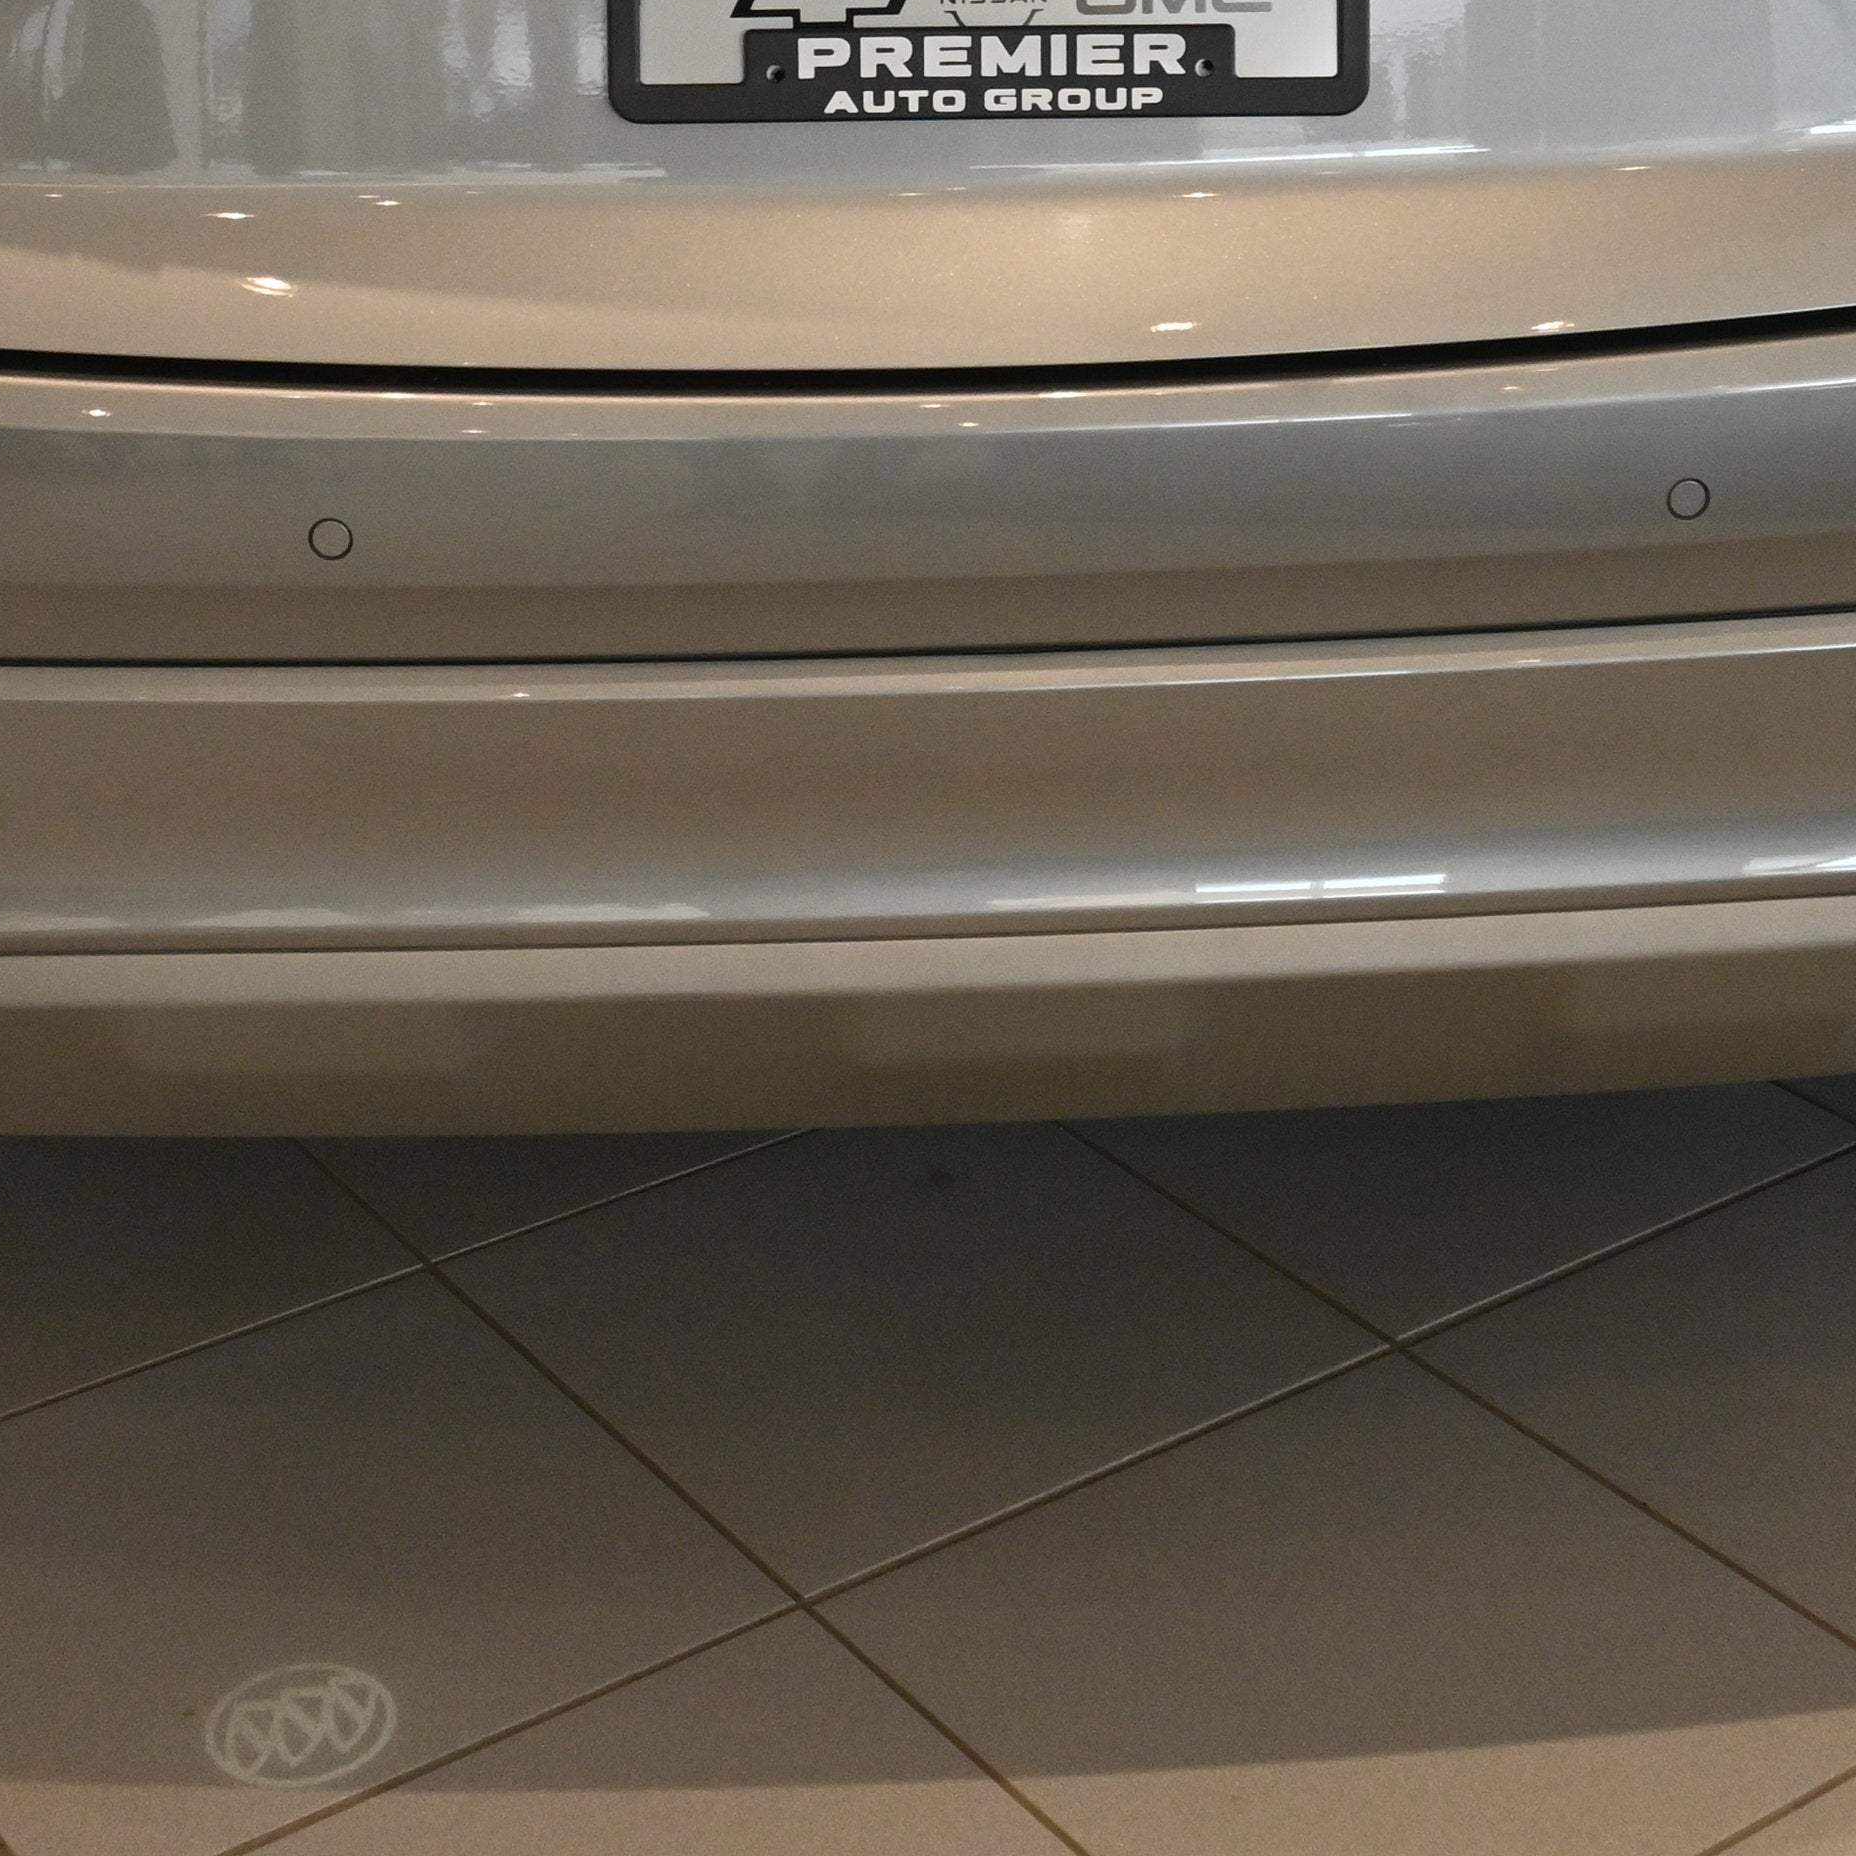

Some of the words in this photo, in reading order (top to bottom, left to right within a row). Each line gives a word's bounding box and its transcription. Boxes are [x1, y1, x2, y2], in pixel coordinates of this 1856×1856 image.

[797, 32, 1187, 79] PREMIER
[823, 88, 967, 115] AUTO
[983, 86, 1164, 112] GROUP
